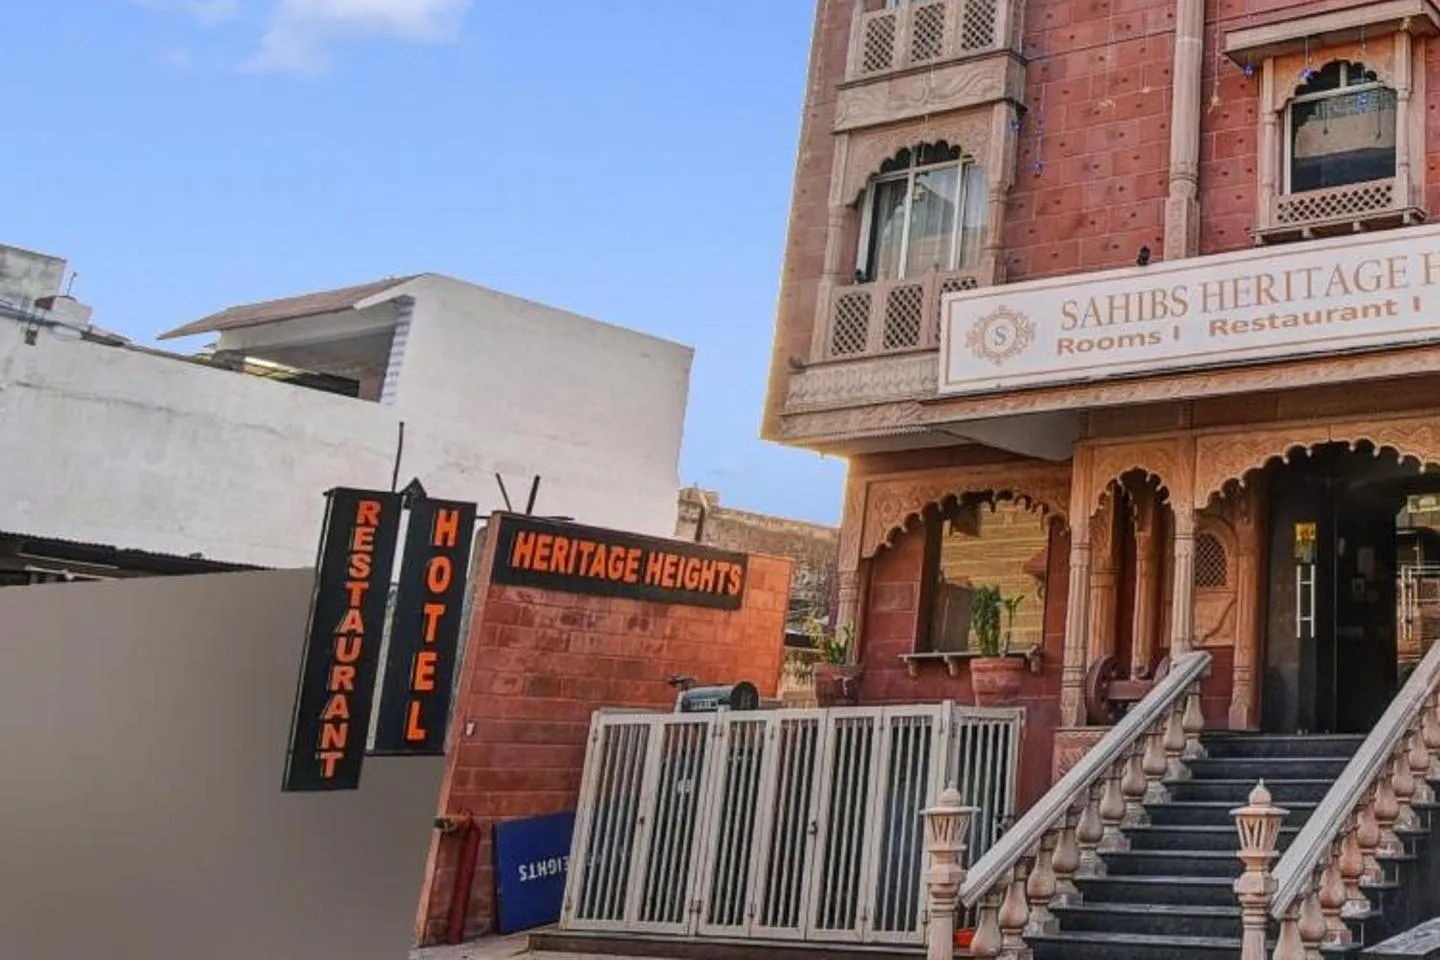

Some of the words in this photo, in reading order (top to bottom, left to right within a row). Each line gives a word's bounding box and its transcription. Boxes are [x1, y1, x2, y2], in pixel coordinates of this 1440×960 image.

[1057, 330, 1162, 356] Rooms
[1208, 298, 1399, 338] Restaurant
[1061, 285, 1189, 332] SAHIBS
[1200, 255, 1410, 314] HERITAGE
[512, 531, 643, 584] HERITAGE
[645, 550, 743, 595] HEIGHTS
[318, 500, 382, 778] RESTAURANT
[405, 508, 460, 741] HOTEL
